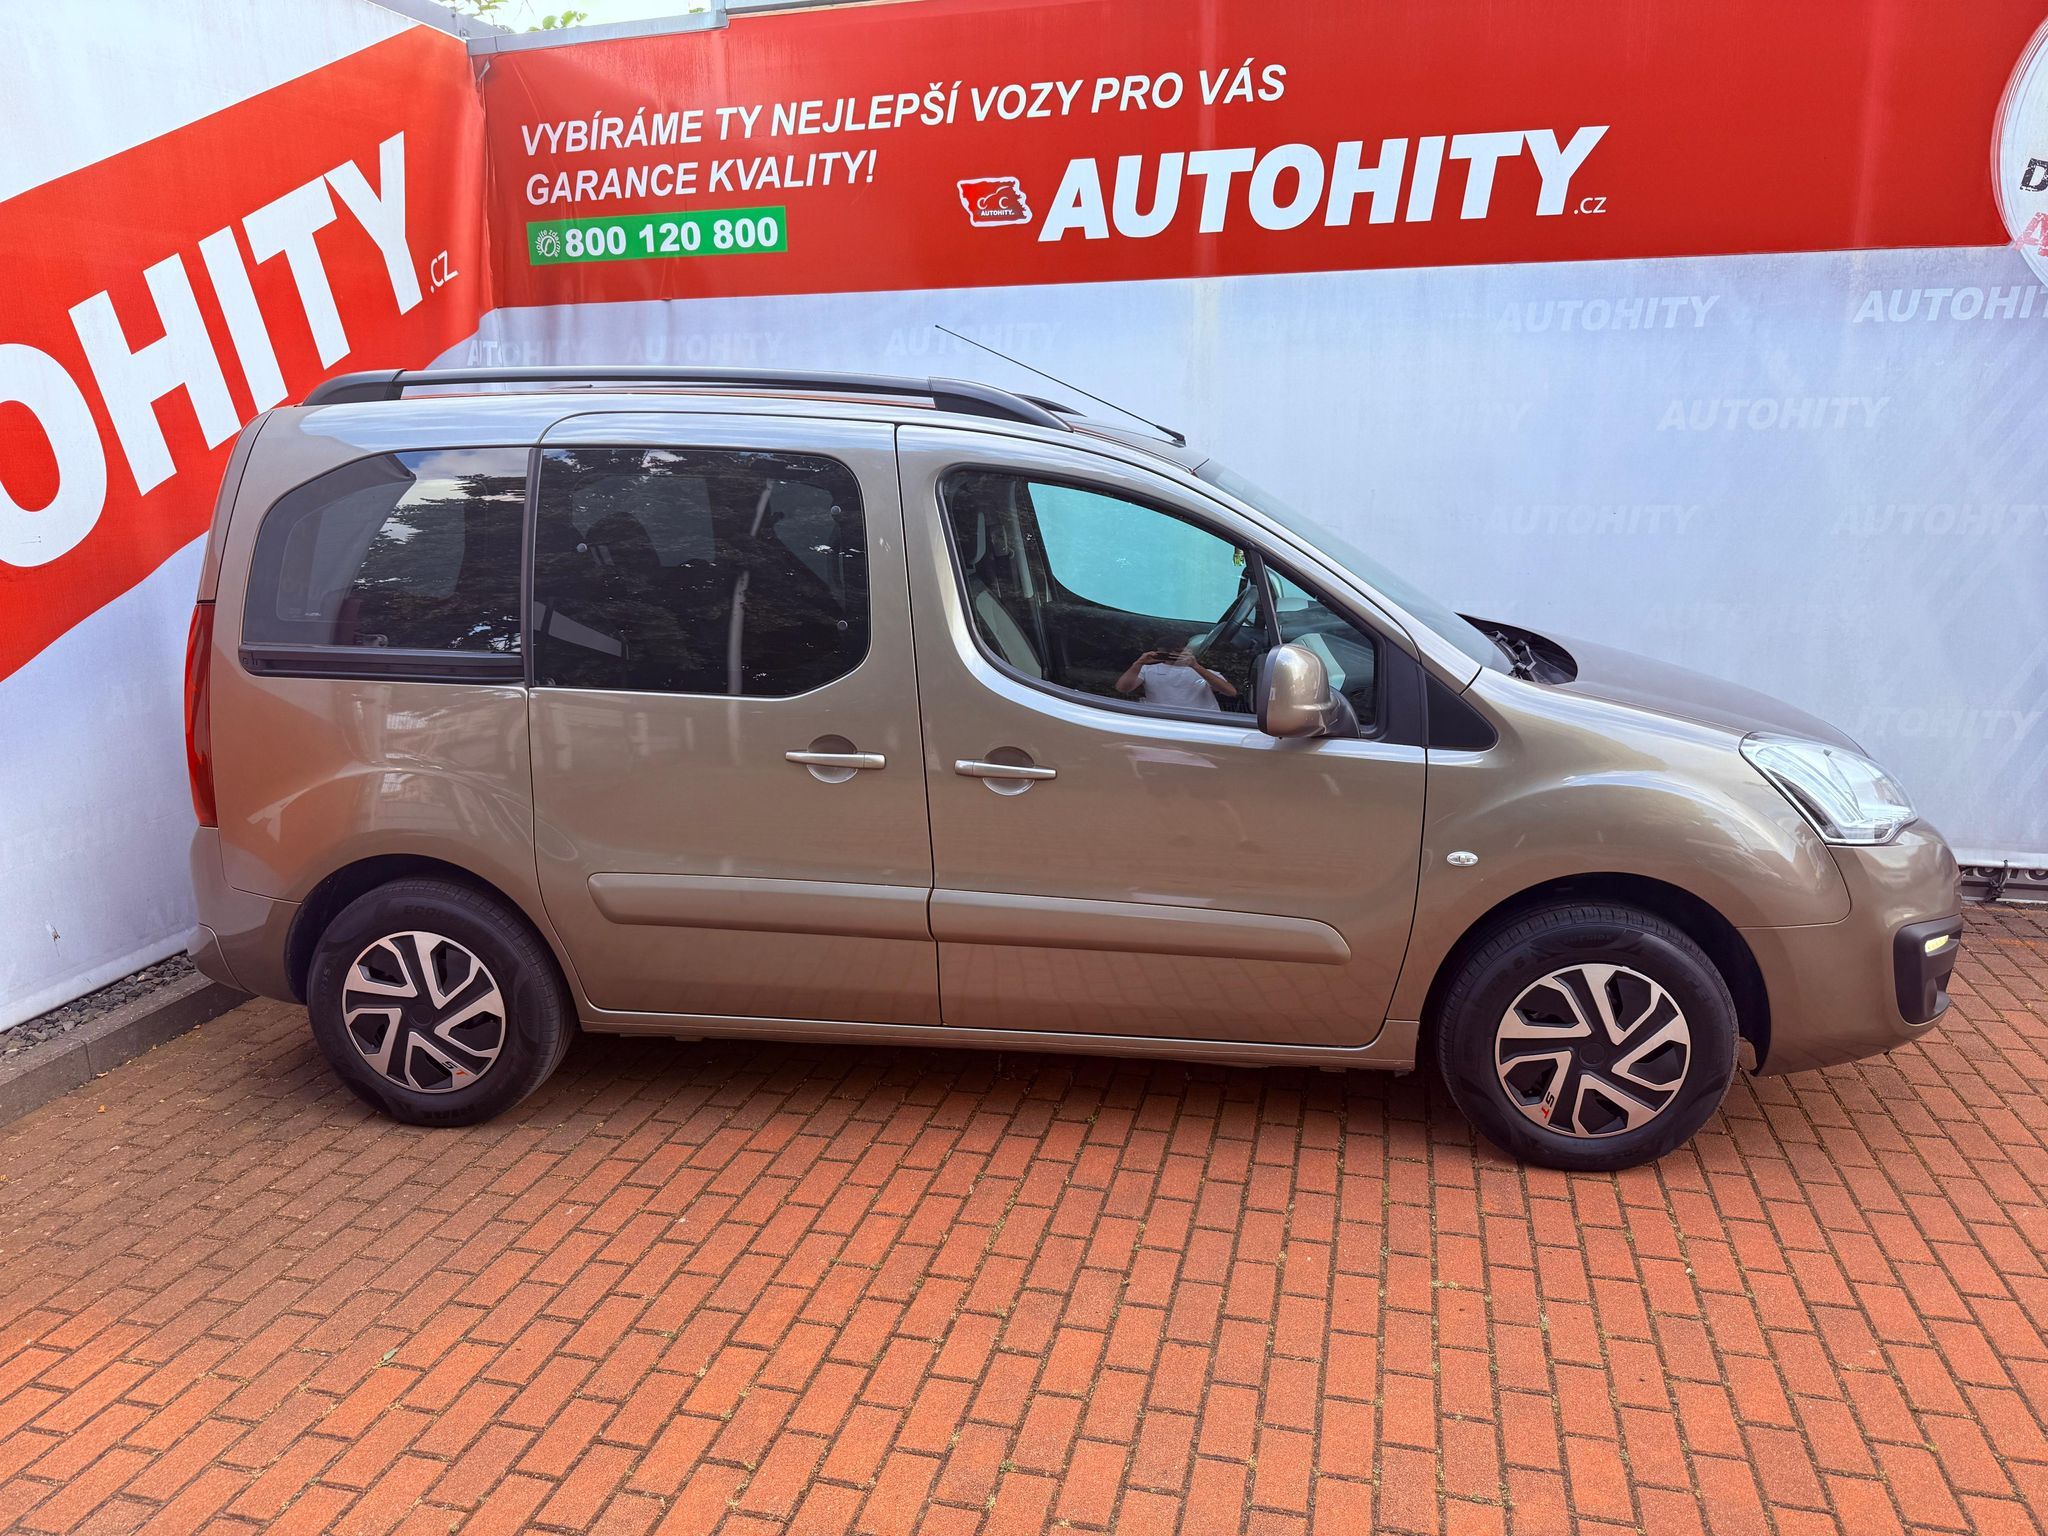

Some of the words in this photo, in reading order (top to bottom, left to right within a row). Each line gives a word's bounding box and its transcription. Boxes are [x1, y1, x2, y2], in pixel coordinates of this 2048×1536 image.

[521, 106, 704, 156] VYBÍRÁME
[715, 104, 763, 141] TY
[770, 80, 963, 137] NEJLEPŠÍ
[970, 79, 1084, 122] VOZY
[1091, 72, 1184, 113] PRO
[1199, 57, 1287, 106] VÁS
[526, 160, 699, 206] GARANCE
[708, 149, 878, 193] KVALITY!
[565, 226, 627, 257] 800
[639, 220, 701, 253] 120
[713, 216, 778, 249] 800
[1497, 294, 1720, 334] AUTOHITY
[1658, 396, 1891, 434] AUTOHITY
[1482, 504, 1702, 536] AUTOHITY
